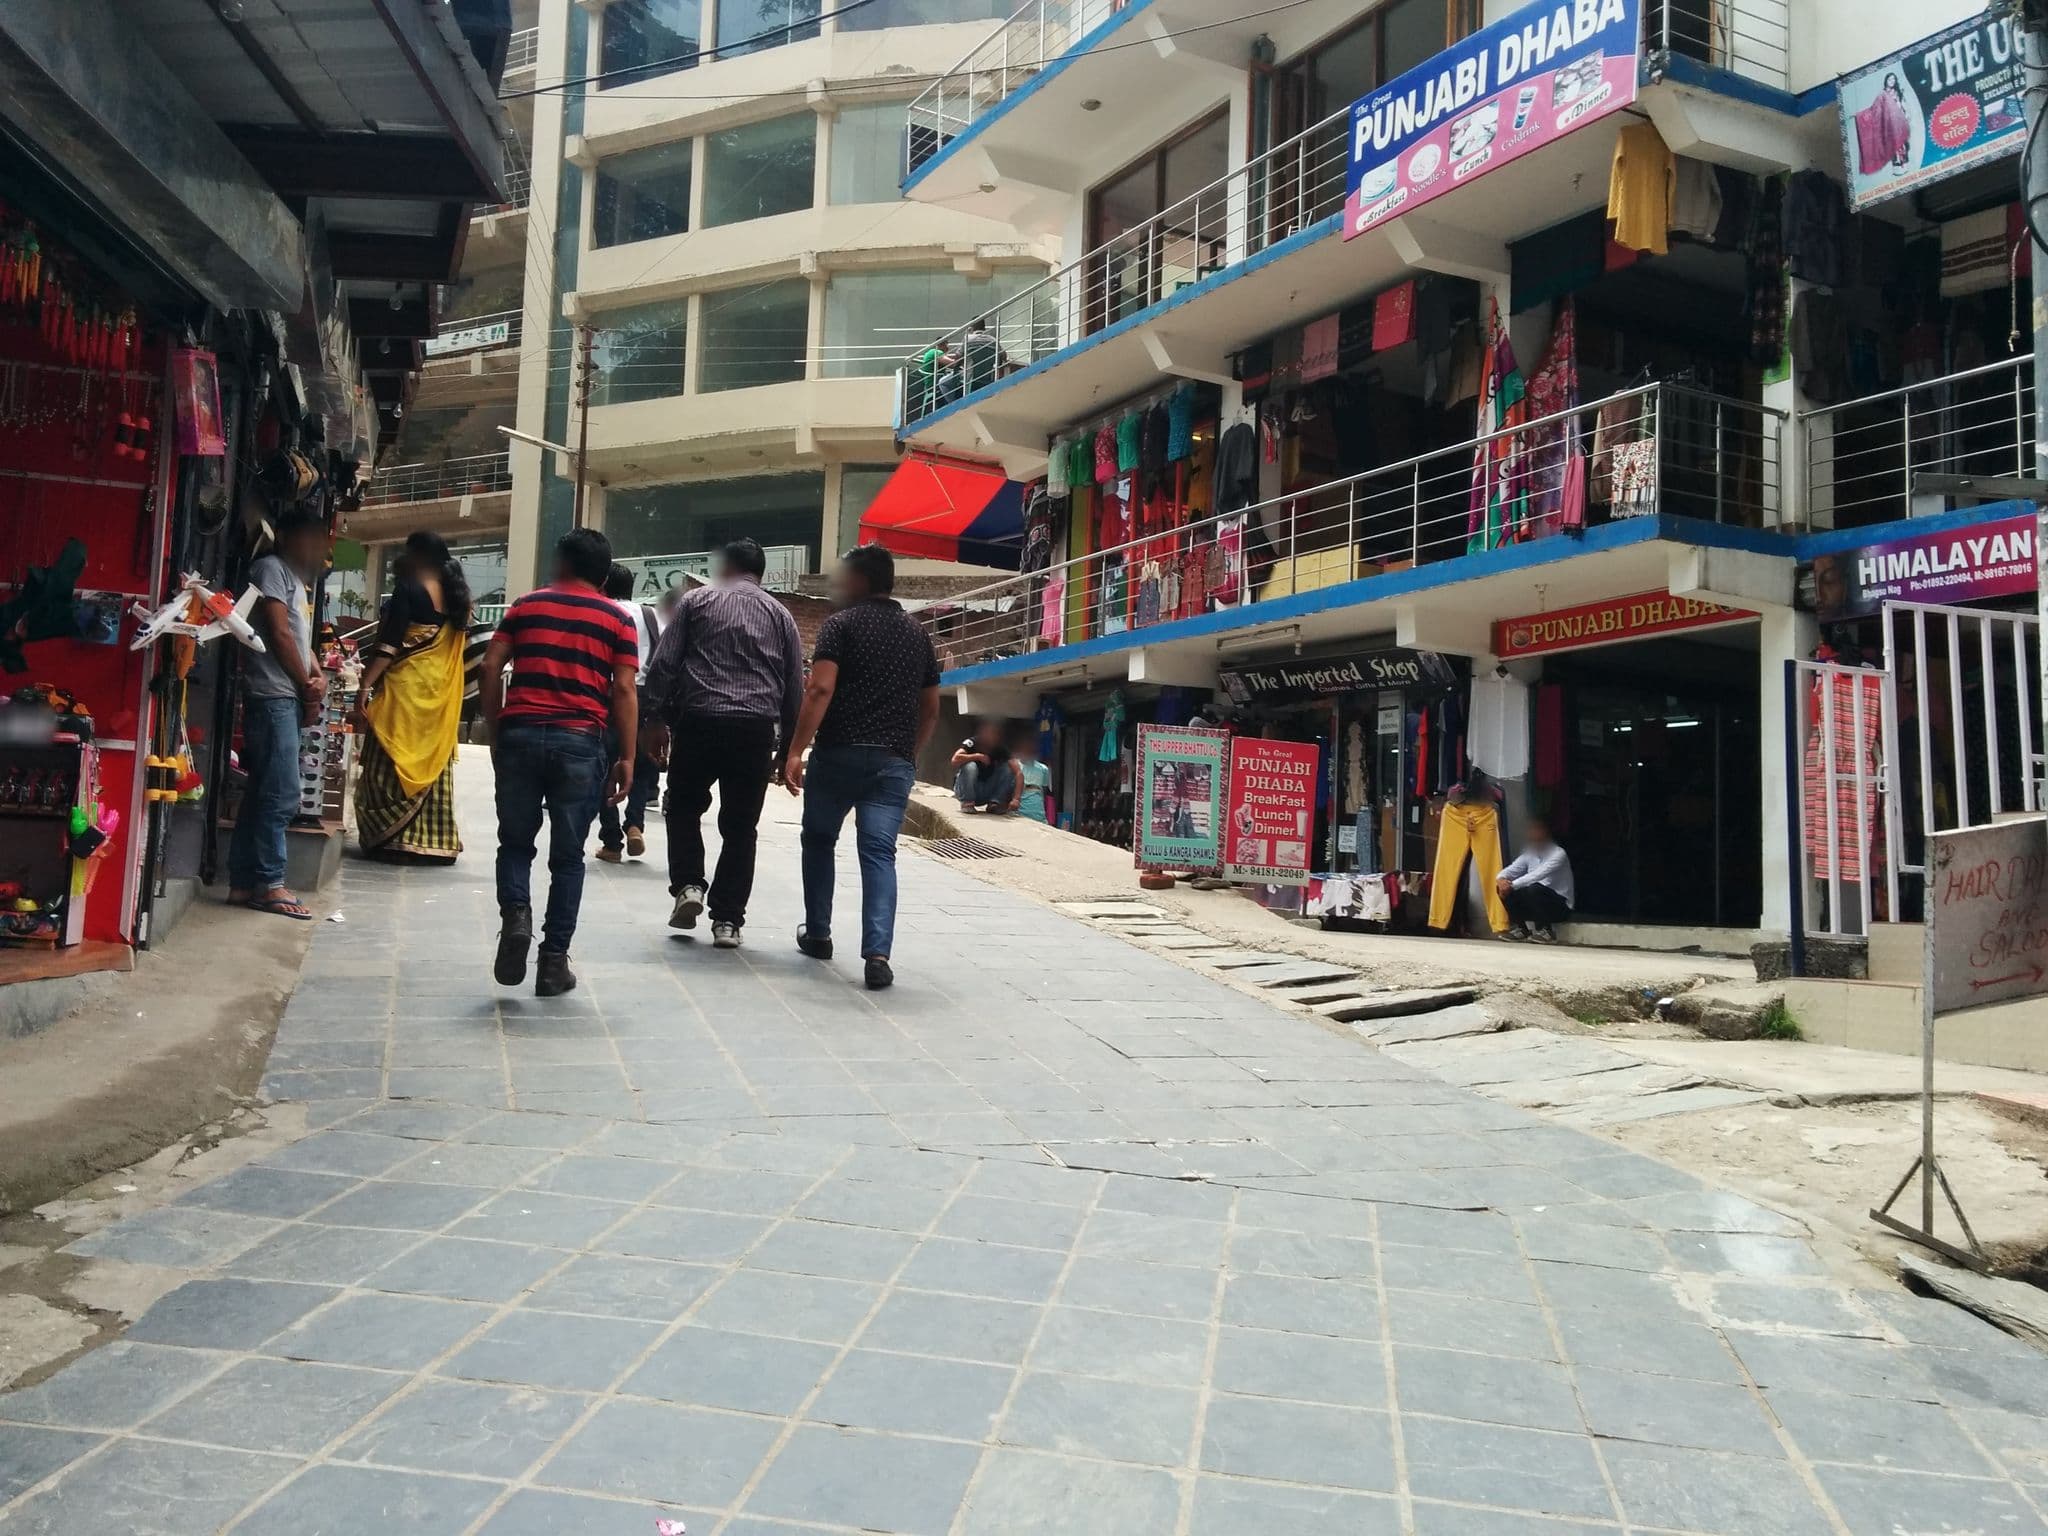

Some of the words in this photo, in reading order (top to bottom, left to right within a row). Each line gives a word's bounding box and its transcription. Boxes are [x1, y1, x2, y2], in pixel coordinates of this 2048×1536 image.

[1924, 30, 1984, 93] THE
[1354, 48, 1489, 163] PUNJABI
[1497, 0, 1626, 86] DHABA
[1356, 103, 1370, 118] The
[1371, 90, 1393, 111] Great
[1569, 88, 1609, 121] Dinner
[1462, 148, 1490, 176] Lunch
[1411, 167, 1449, 197] Noodle's
[1367, 190, 1406, 225] Breakfast
[1858, 529, 2033, 586] HIMALAYAN
[1530, 607, 1625, 644] PUNJABI
[1630, 598, 1719, 628] DHABA
[1246, 672, 1279, 692] The
[1280, 661, 1363, 692] Imported
[1369, 657, 1420, 681] Shop
[1238, 756, 1312, 776] PUNJABI
[1257, 747, 1271, 758] The
[1273, 749, 1293, 759] Great
[1244, 774, 1306, 793] DHABA
[1244, 791, 1306, 808] BreakFast
[1254, 822, 1296, 836] Dinner
[1255, 808, 1293, 822] Lunch
[1250, 866, 1305, 879] 94181-22049
[1944, 859, 2003, 905] HAIR
